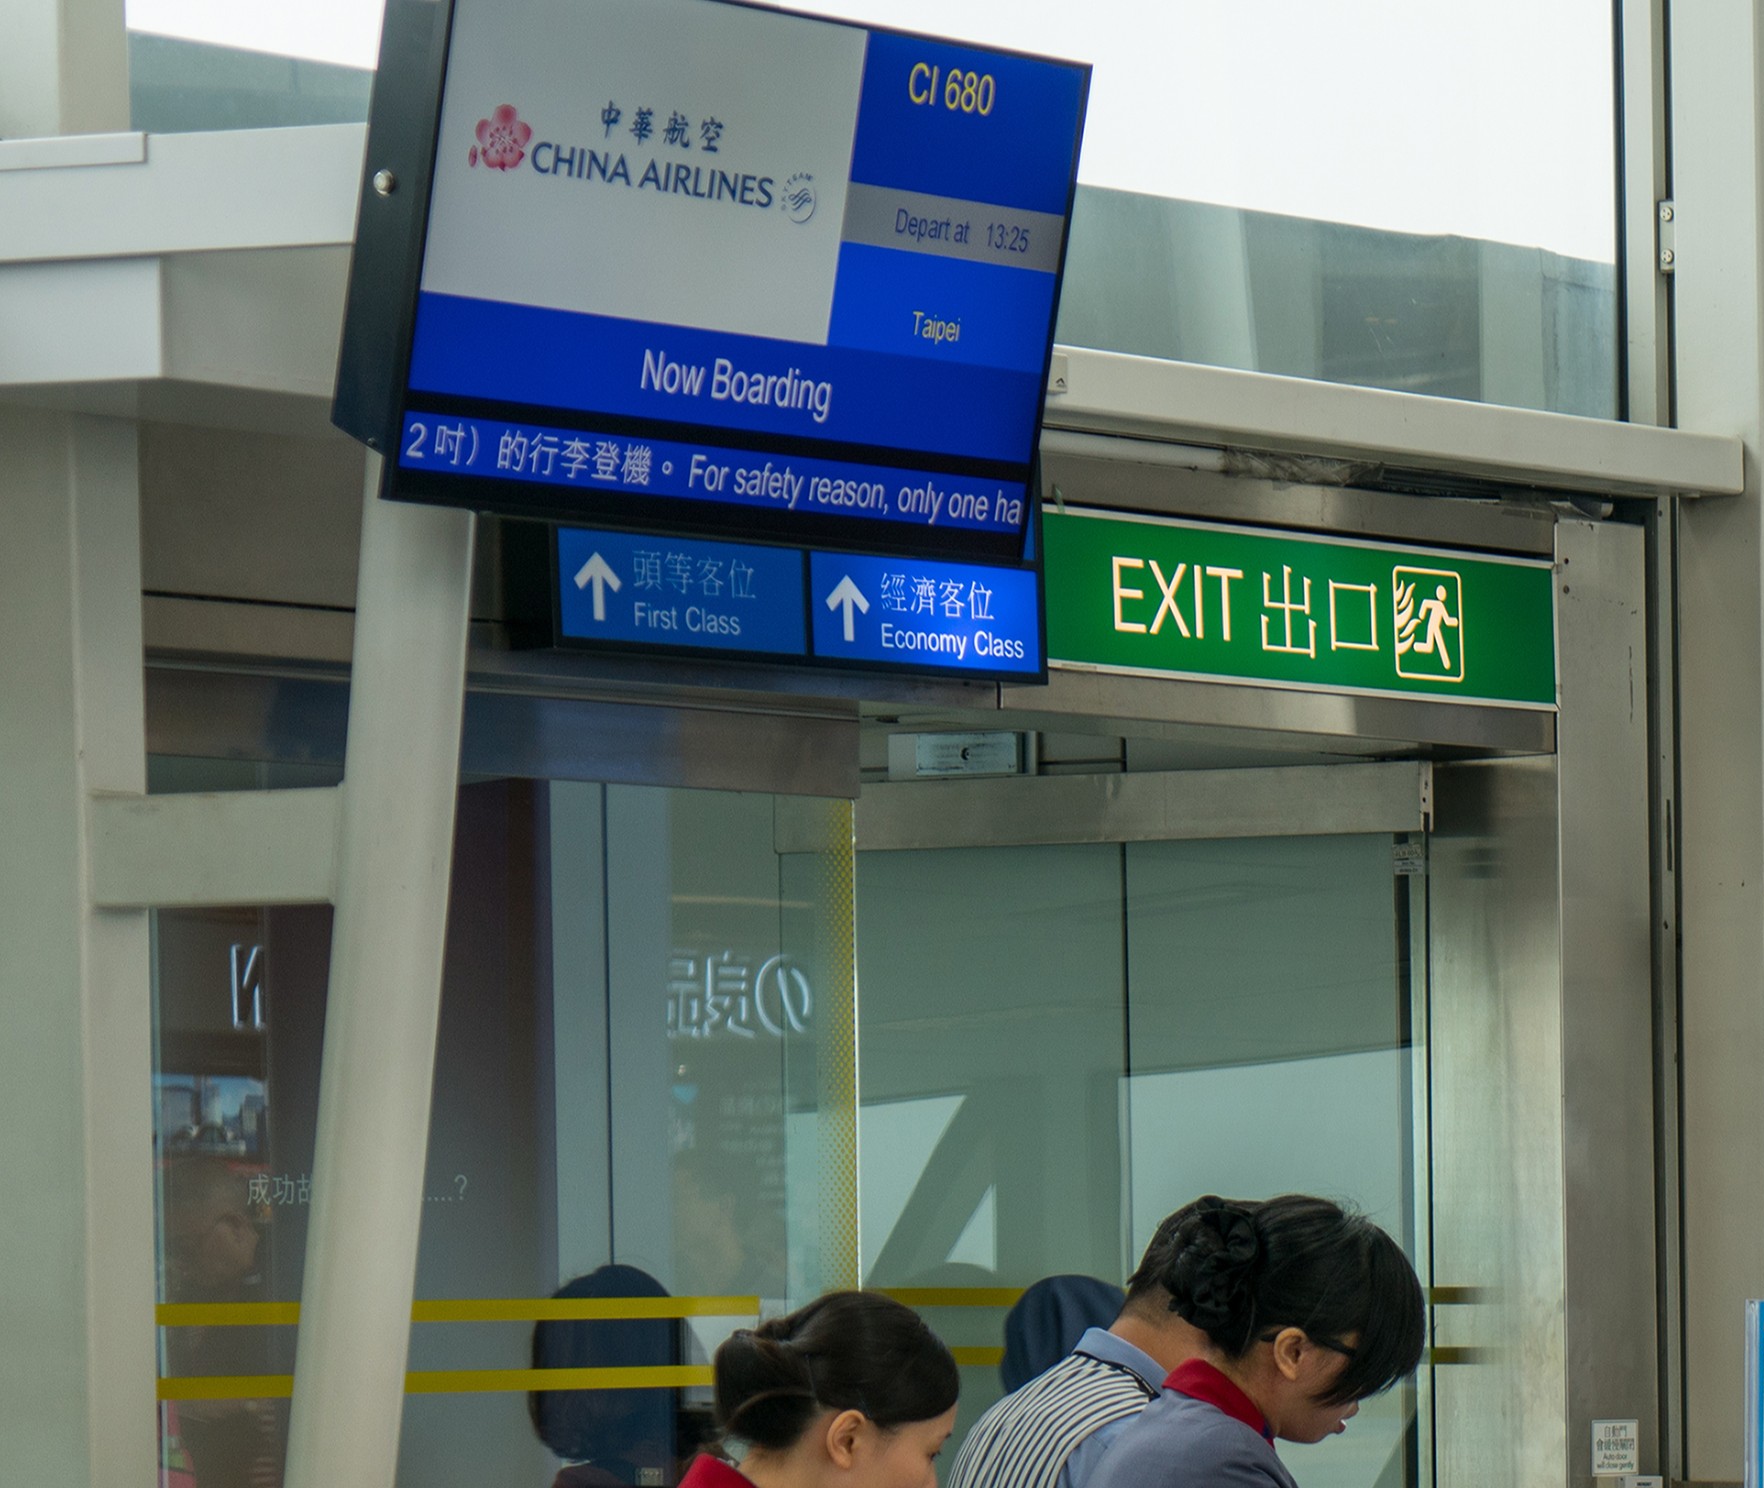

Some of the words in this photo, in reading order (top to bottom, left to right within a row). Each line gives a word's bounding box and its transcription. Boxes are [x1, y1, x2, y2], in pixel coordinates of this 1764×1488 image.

[908, 62, 939, 106] CI
[945, 68, 996, 116] 680
[601, 100, 724, 153] 中華航空
[530, 142, 631, 186] CHINA
[638, 158, 774, 208] AIRLINES
[895, 208, 950, 243] Depart
[953, 220, 970, 244] at
[987, 223, 1030, 253] 13:25
[912, 311, 961, 345] Taipei
[640, 349, 705, 396] Now
[710, 357, 833, 424] Boarding
[688, 454, 729, 492] For
[734, 461, 803, 510] safety
[808, 475, 889, 515] reason,
[897, 481, 945, 525] only
[948, 494, 988, 524] one
[995, 490, 1022, 525] ha
[632, 550, 756, 600] 頭等客位
[880, 573, 996, 620] 經濟客位
[634, 602, 678, 631] First
[686, 606, 741, 637] Class
[1111, 556, 1244, 642] EXIT
[1260, 565, 1380, 659] 出口
[881, 624, 966, 660] Economy
[974, 629, 1025, 660] Class
